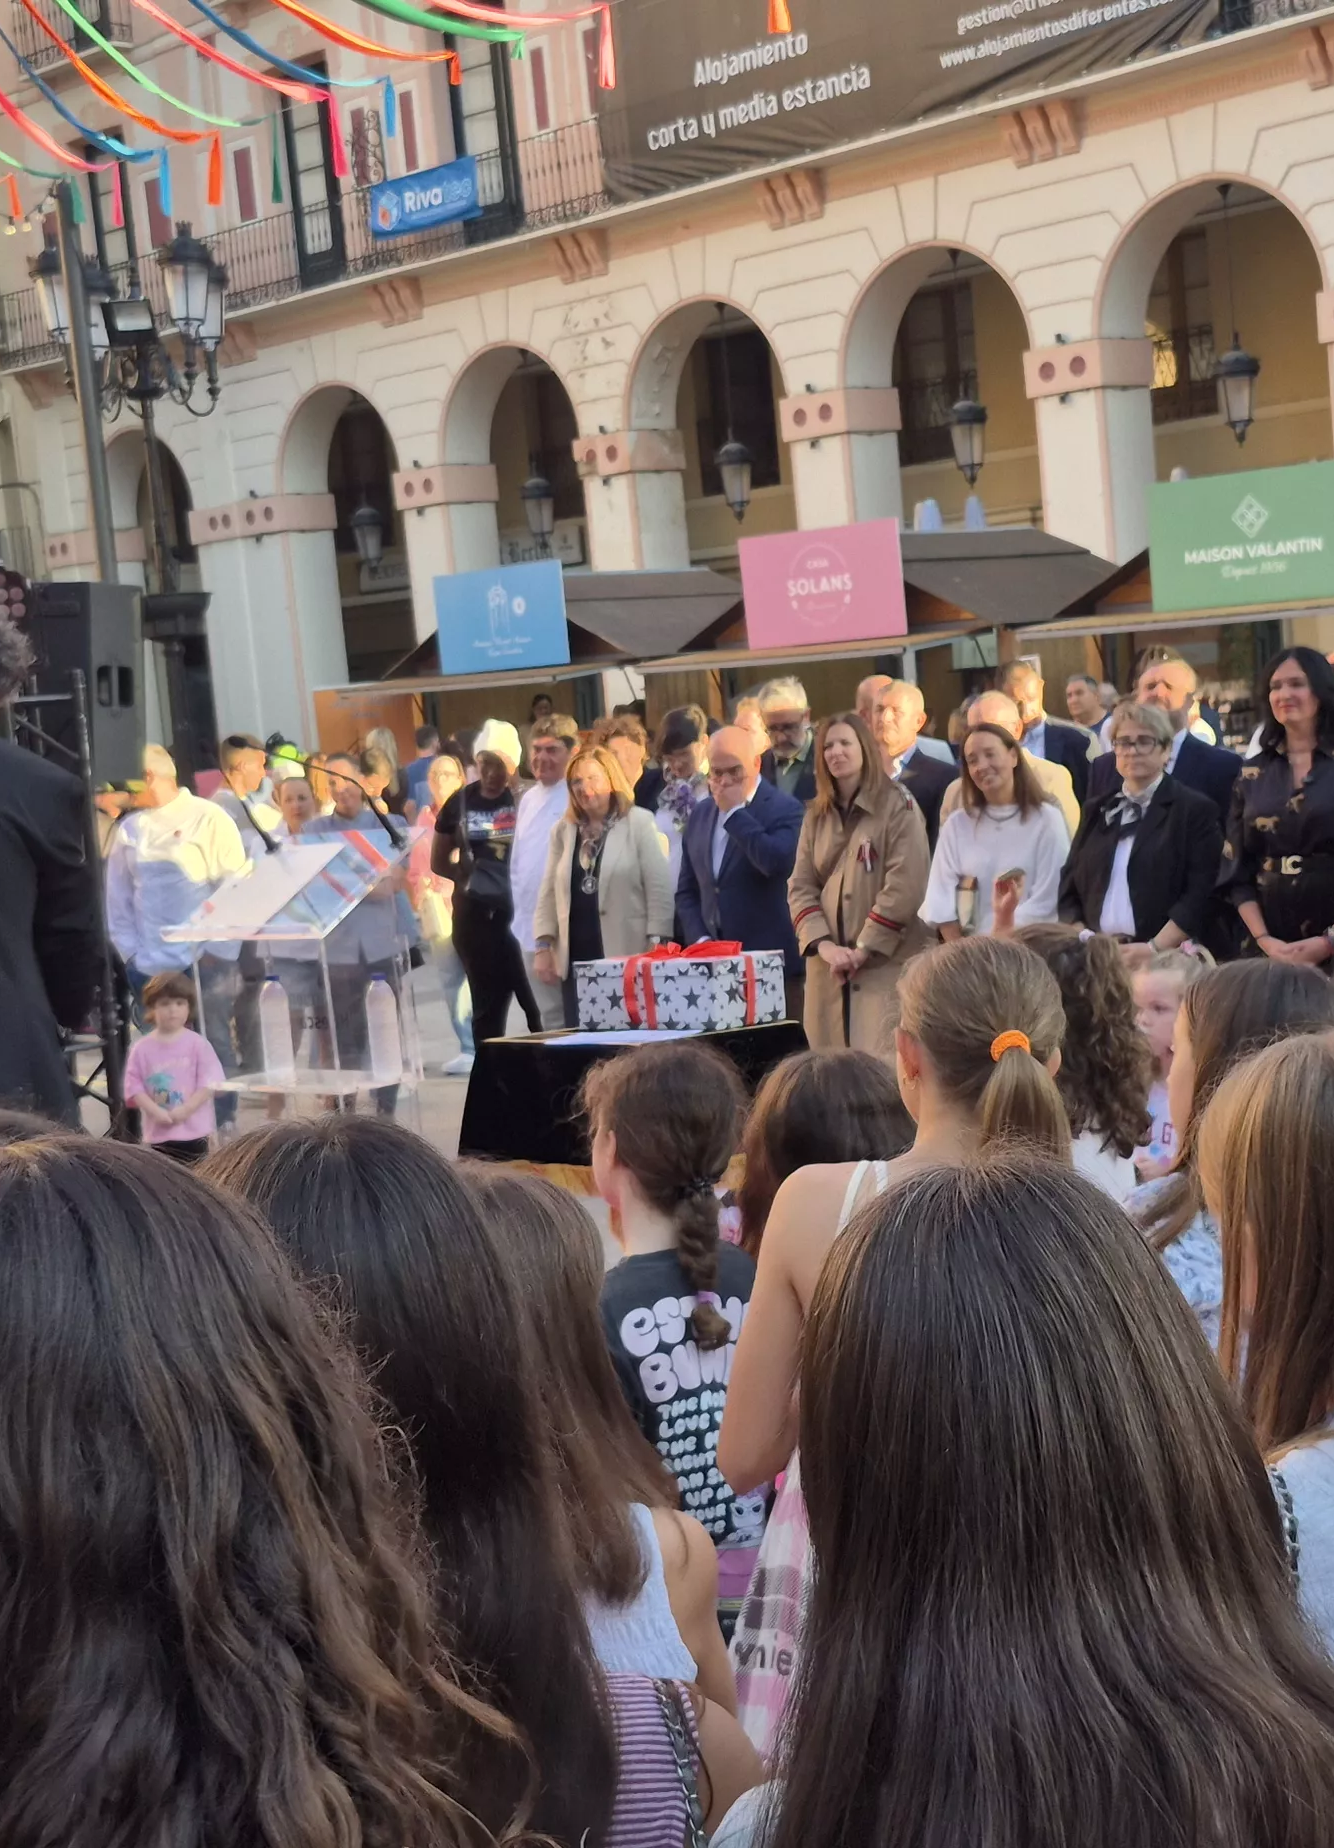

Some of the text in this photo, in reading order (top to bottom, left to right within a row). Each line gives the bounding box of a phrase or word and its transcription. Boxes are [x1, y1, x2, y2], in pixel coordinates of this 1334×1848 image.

[694, 31, 808, 87] Alojamiento
[647, 62, 871, 151] corta y media estancia
[1185, 536, 1324, 564] MAISON VALANTIN
[787, 573, 853, 597] SOLANS
[659, 1412, 710, 1438] LOVE
